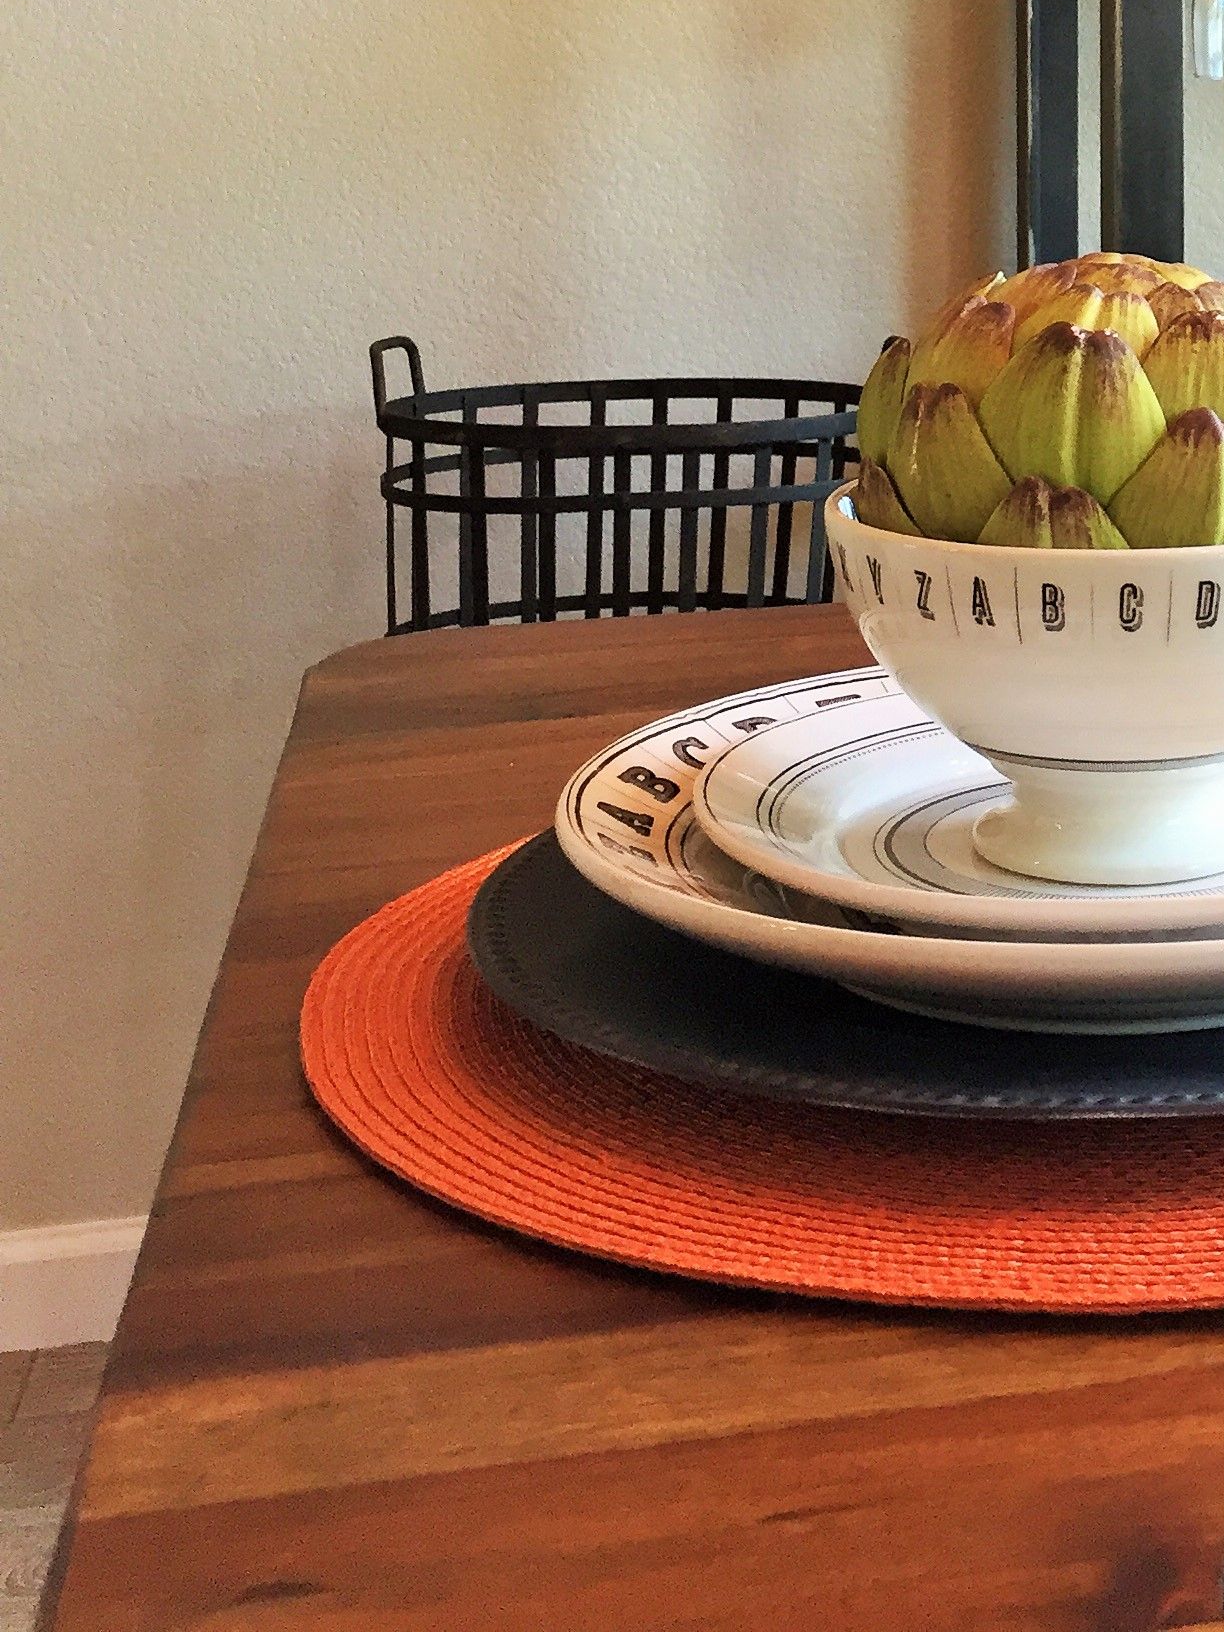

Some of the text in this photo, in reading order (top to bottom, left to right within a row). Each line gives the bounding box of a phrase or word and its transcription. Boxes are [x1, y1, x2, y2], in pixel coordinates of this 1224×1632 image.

[914, 569, 936, 621] Z
[972, 576, 997, 627] A
[1041, 583, 1066, 632] B
[1119, 582, 1144, 632] C
[1195, 580, 1221, 629] D
[616, 765, 681, 804] B
